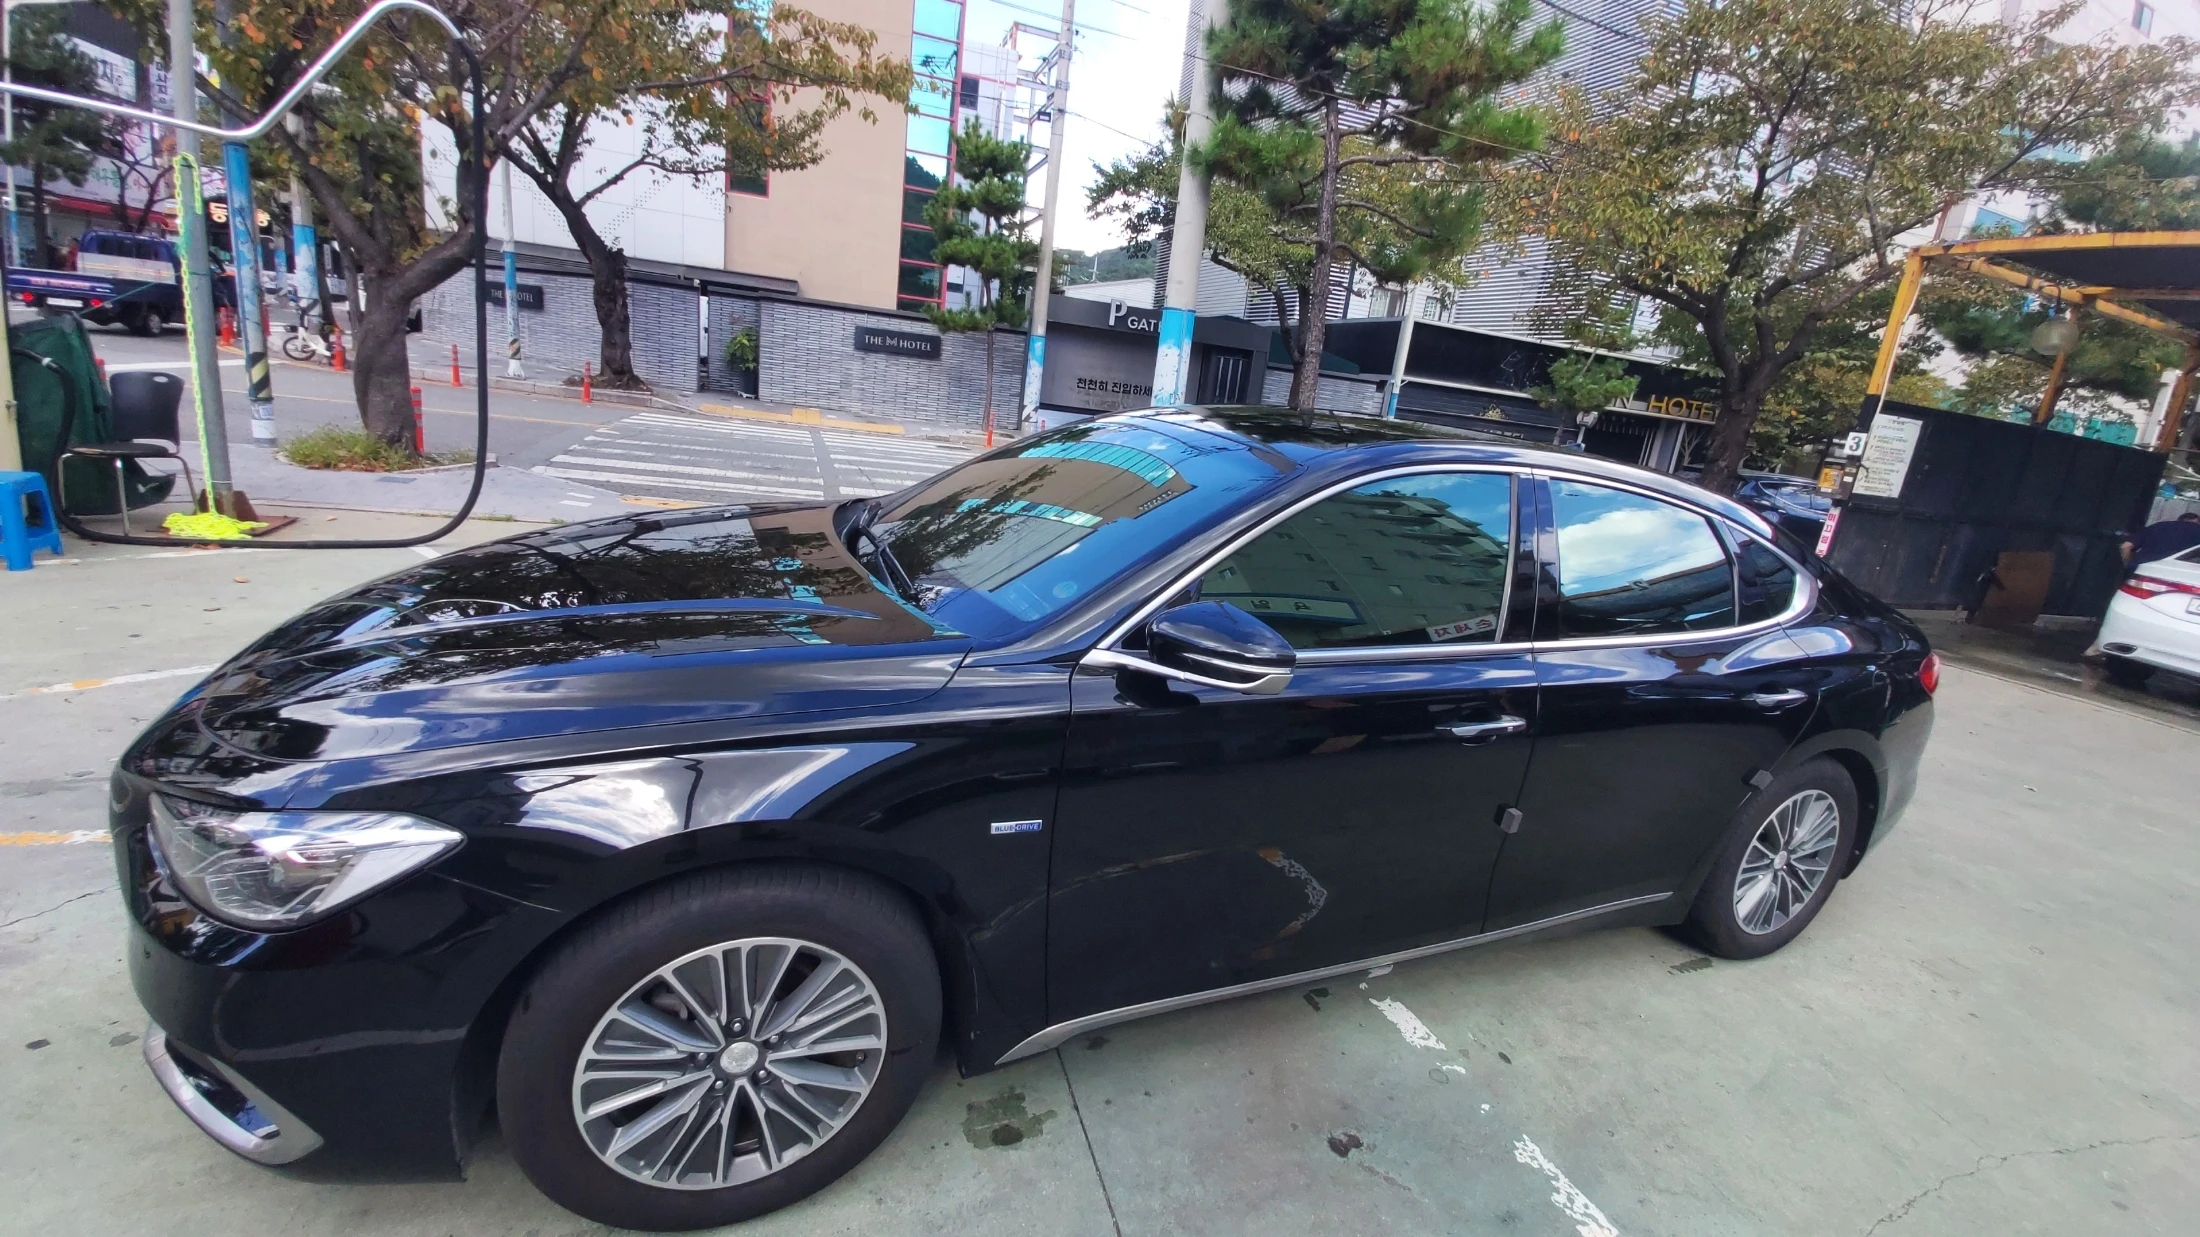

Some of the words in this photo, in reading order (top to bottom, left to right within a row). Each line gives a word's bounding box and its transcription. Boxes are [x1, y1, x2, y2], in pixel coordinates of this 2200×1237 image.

[491, 289, 503, 299] THE
[1108, 299, 1128, 326] P
[864, 334, 884, 346] THE
[900, 339, 932, 352] HOTEL
[1076, 378, 1108, 392] 천천히
[1849, 436, 1862, 452] 3
